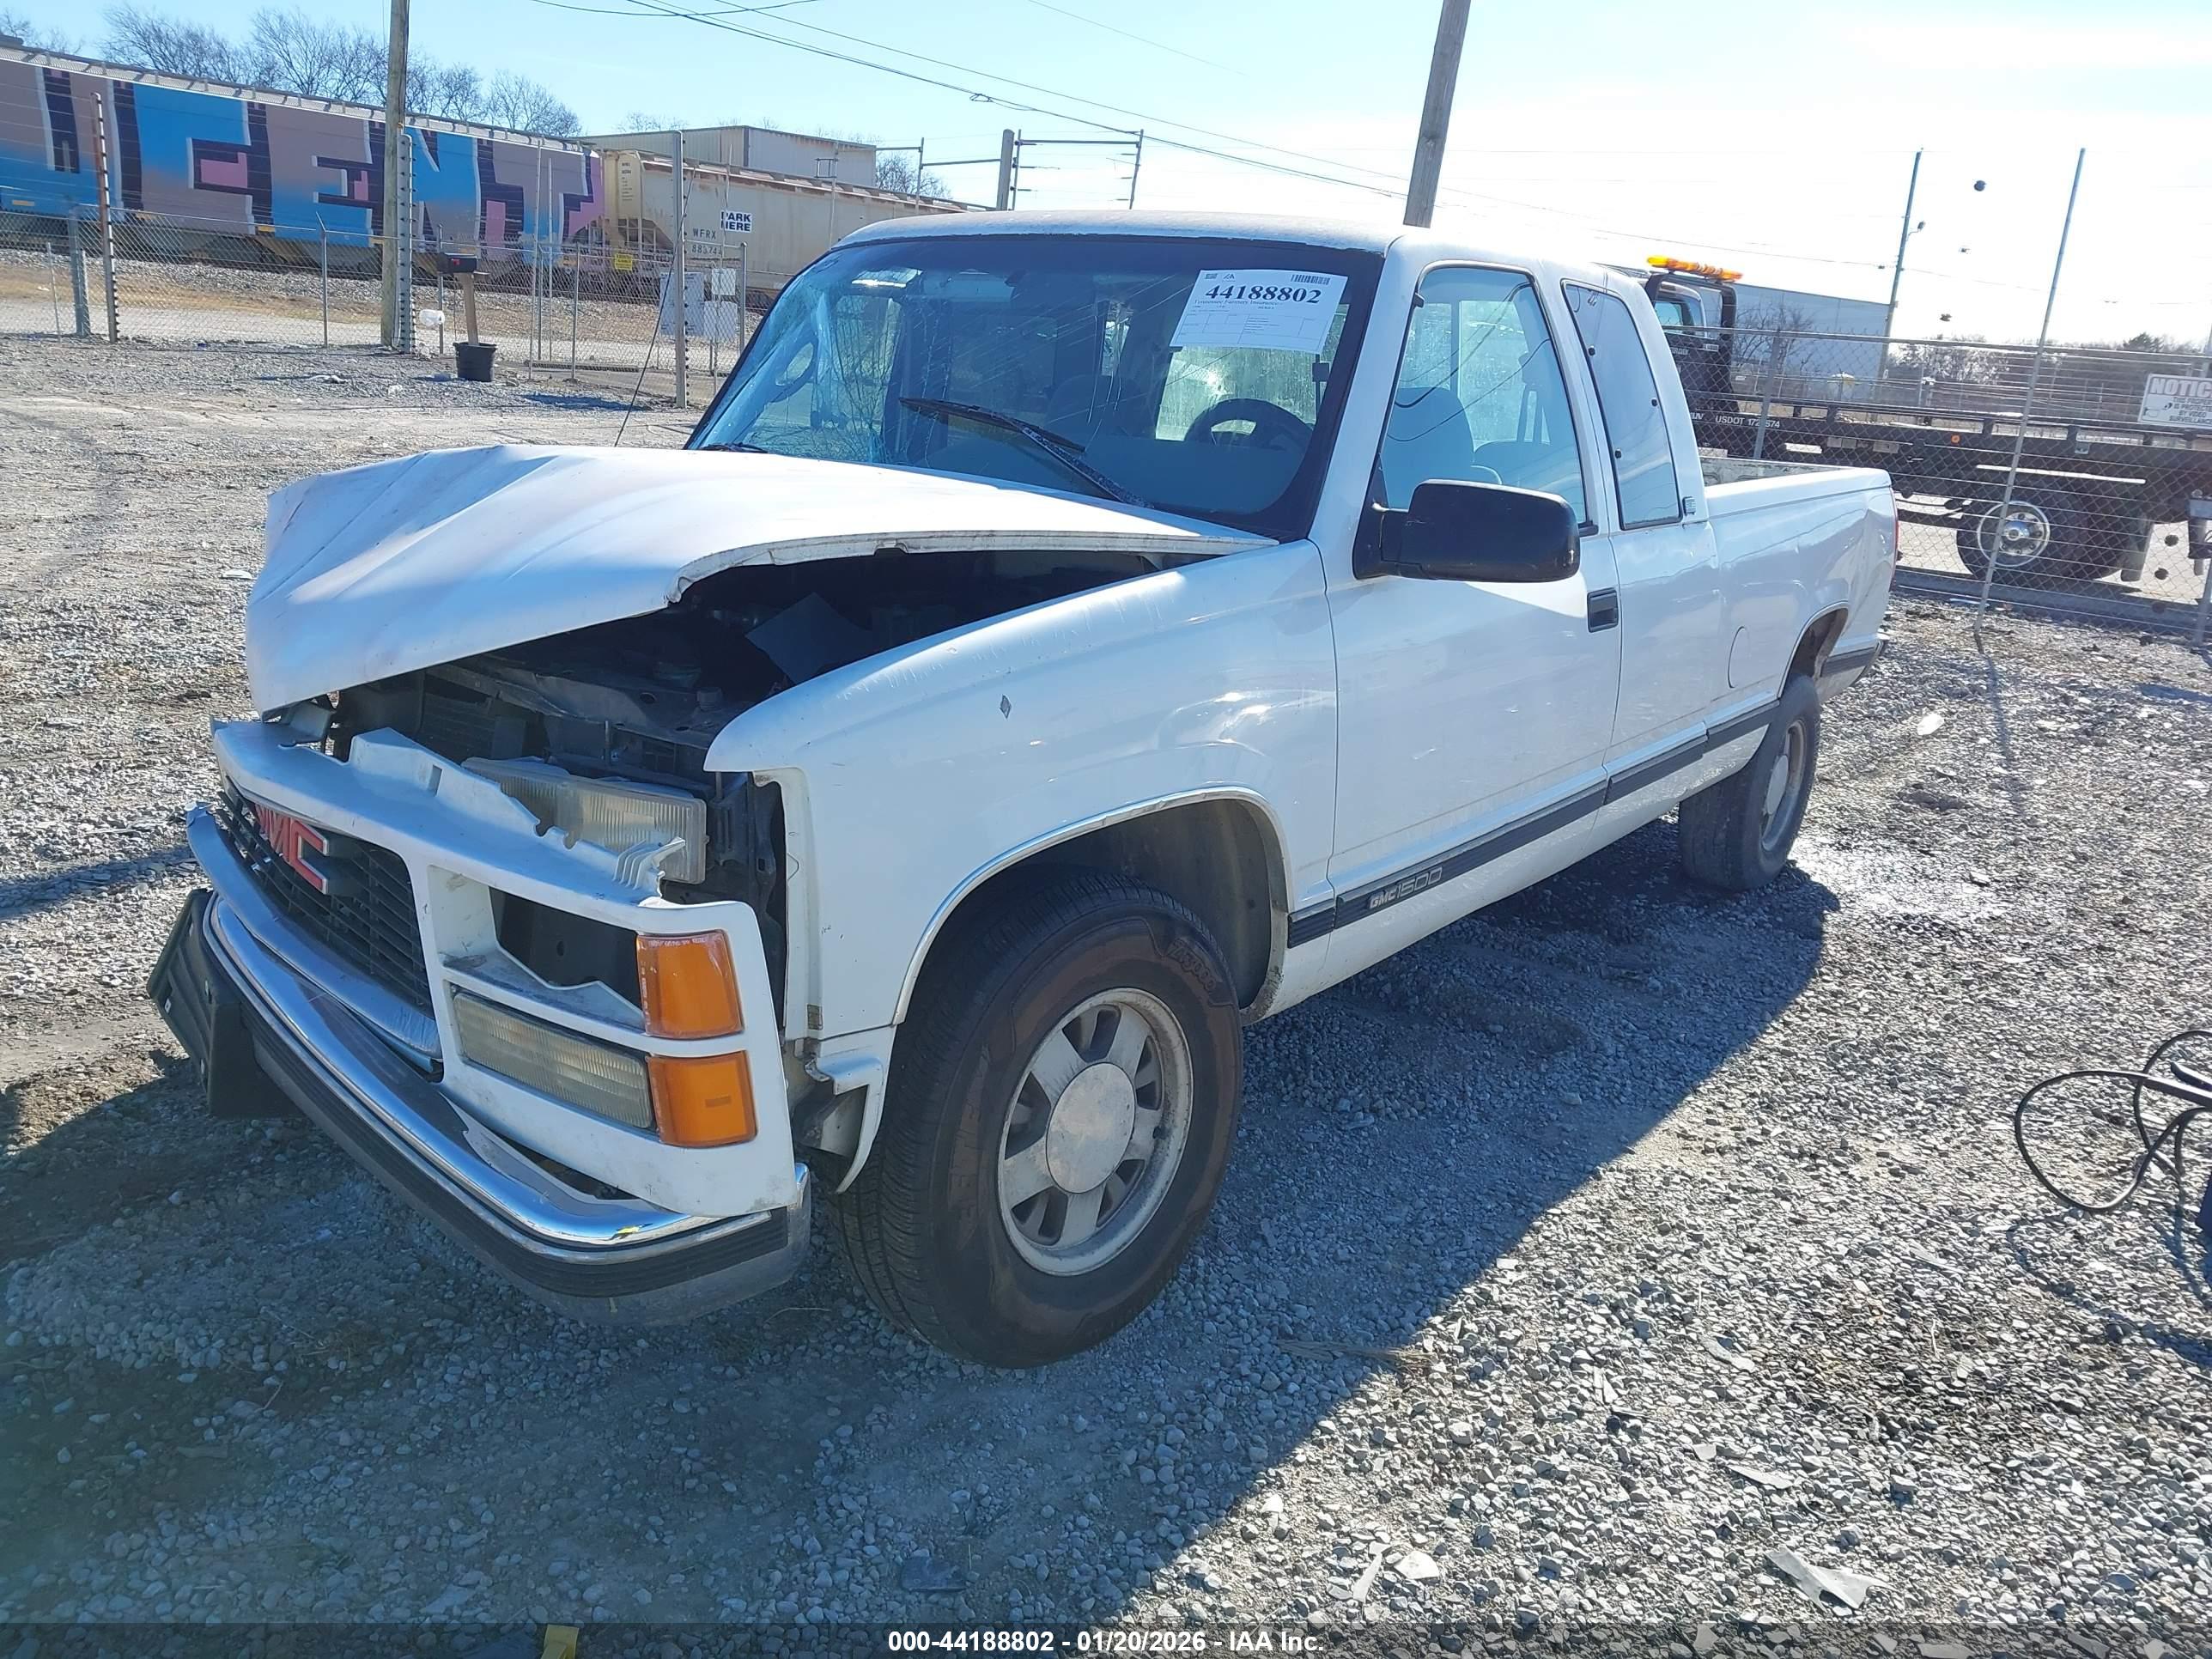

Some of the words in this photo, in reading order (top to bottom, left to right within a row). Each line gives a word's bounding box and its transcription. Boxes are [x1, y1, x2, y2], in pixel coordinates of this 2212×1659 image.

[720, 211, 751, 222] PARK
[692, 228, 716, 240] WFRX
[720, 221, 750, 232] HERE
[1205, 285, 1322, 304] 44188802
[2150, 378, 2212, 398] NOTIC
[1716, 415, 1745, 425] USDOT
[254, 803, 329, 895] MC
[1370, 885, 1399, 909] GMC
[1396, 866, 1443, 899] 1500
